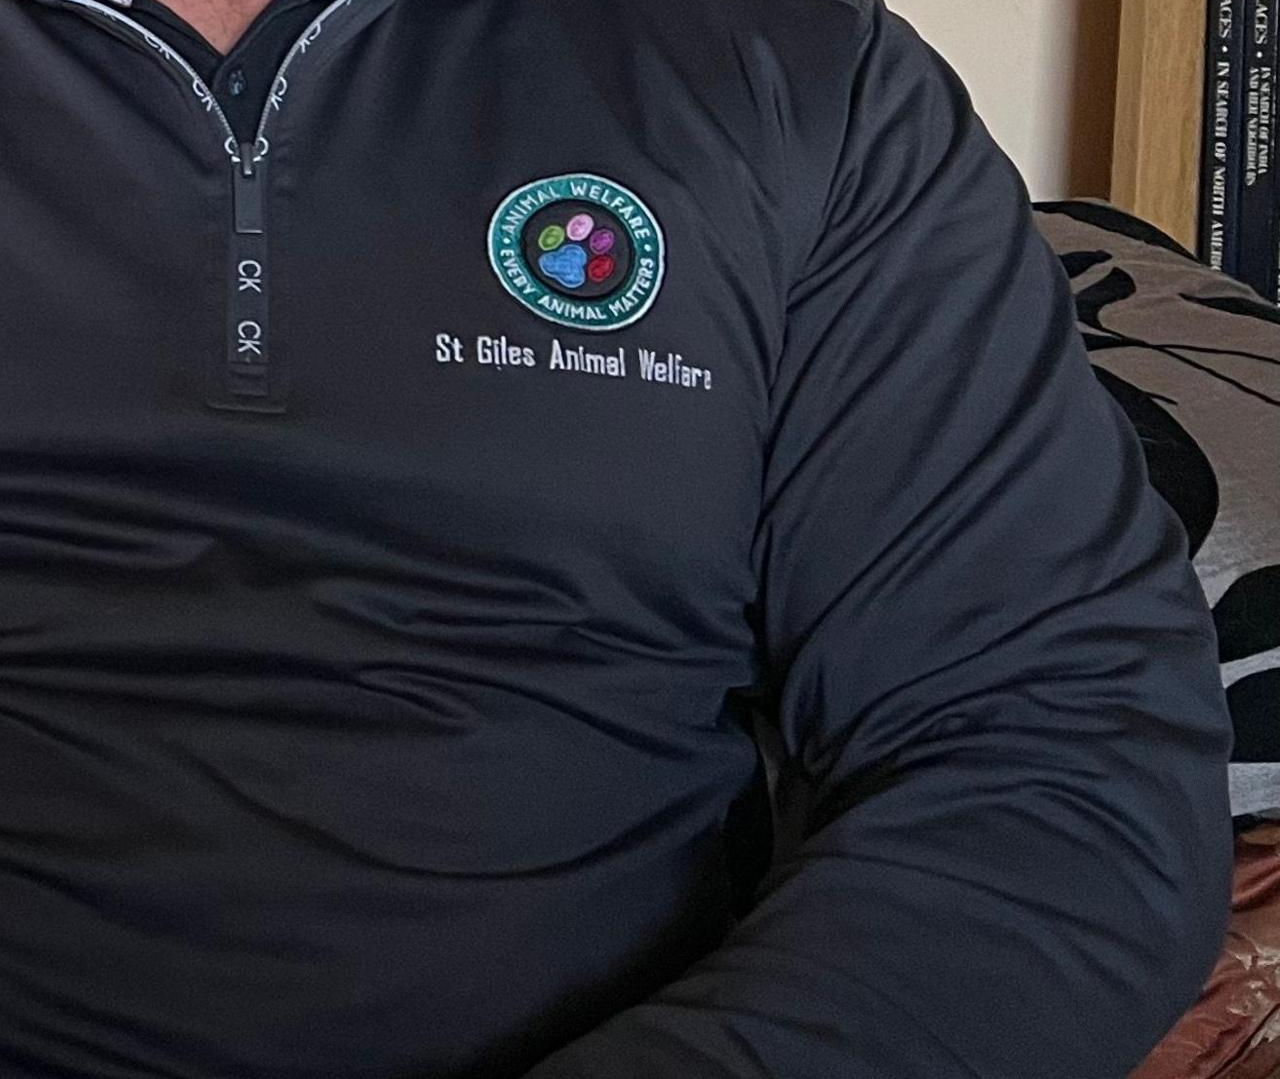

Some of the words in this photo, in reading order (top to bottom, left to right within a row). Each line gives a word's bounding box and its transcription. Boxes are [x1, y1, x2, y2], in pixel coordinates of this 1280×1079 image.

[1217, 61, 1230, 77] IN
[1215, 80, 1229, 138] SEARCH
[1259, 82, 1271, 124] SEARCH
[1214, 141, 1227, 162] OF
[501, 185, 561, 235] ANIMAL
[569, 181, 652, 240] WELFARE
[1212, 166, 1226, 216] NORTH
[237, 260, 262, 293] CK
[500, 248, 536, 295] EVERY
[539, 295, 607, 320] ANIMAL
[608, 257, 655, 317] MATTERS
[237, 320, 262, 356] CK
[435, 333, 464, 363] St
[477, 336, 536, 367] Giles
[549, 339, 627, 378] Animal
[639, 348, 713, 391] Welfare
